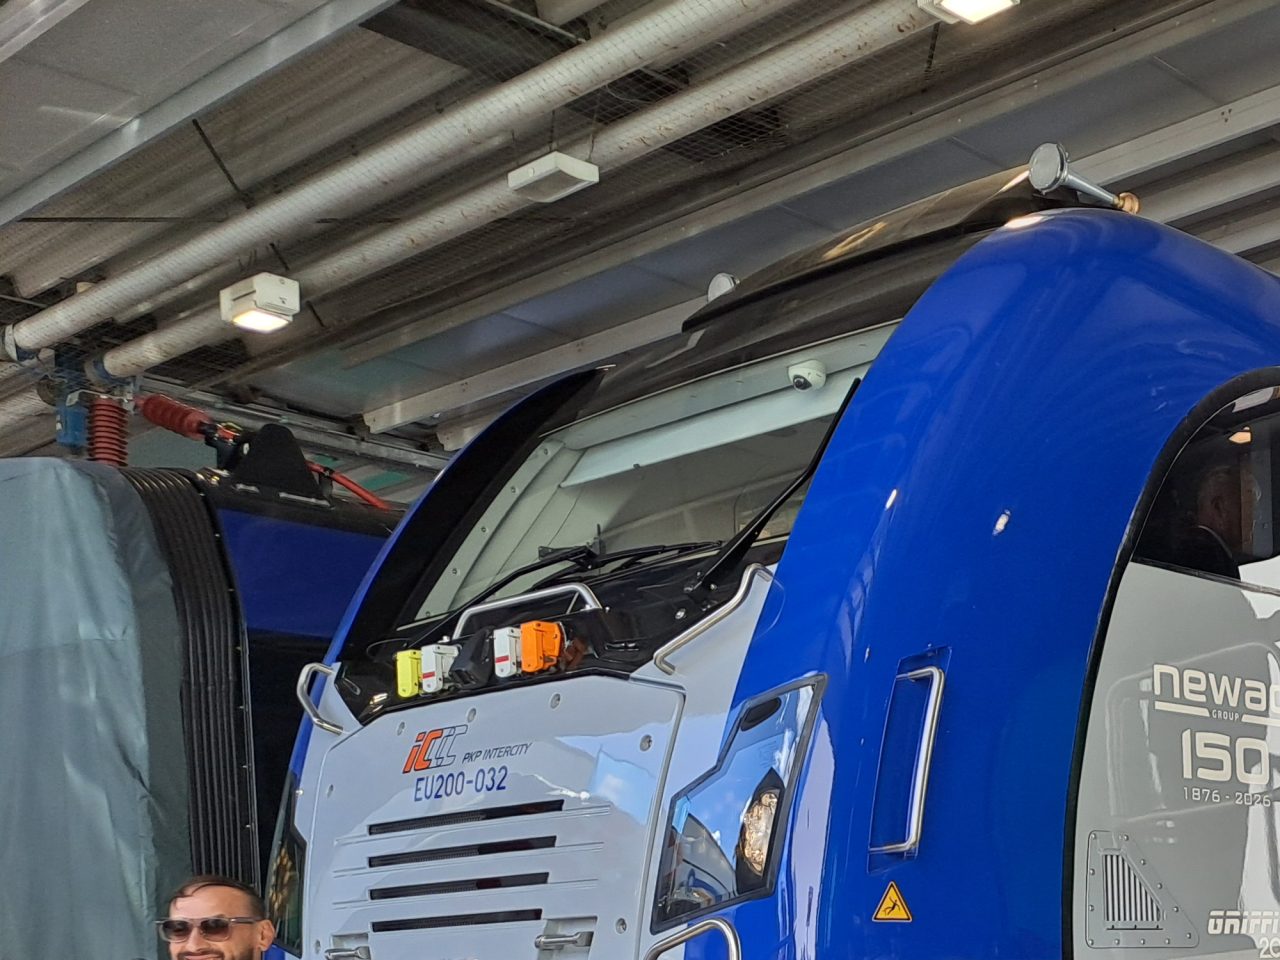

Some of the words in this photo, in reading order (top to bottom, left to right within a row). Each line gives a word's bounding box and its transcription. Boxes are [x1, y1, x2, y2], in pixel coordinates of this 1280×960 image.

[1211, 708, 1241, 721] GROUP
[461, 750, 483, 764] PKP
[483, 742, 533, 761] INTERCITY
[1181, 728, 1270, 785] 150
[413, 765, 508, 802] EU200-032
[1183, 786, 1221, 802] 1876
[1235, 791, 1271, 807] 2026
